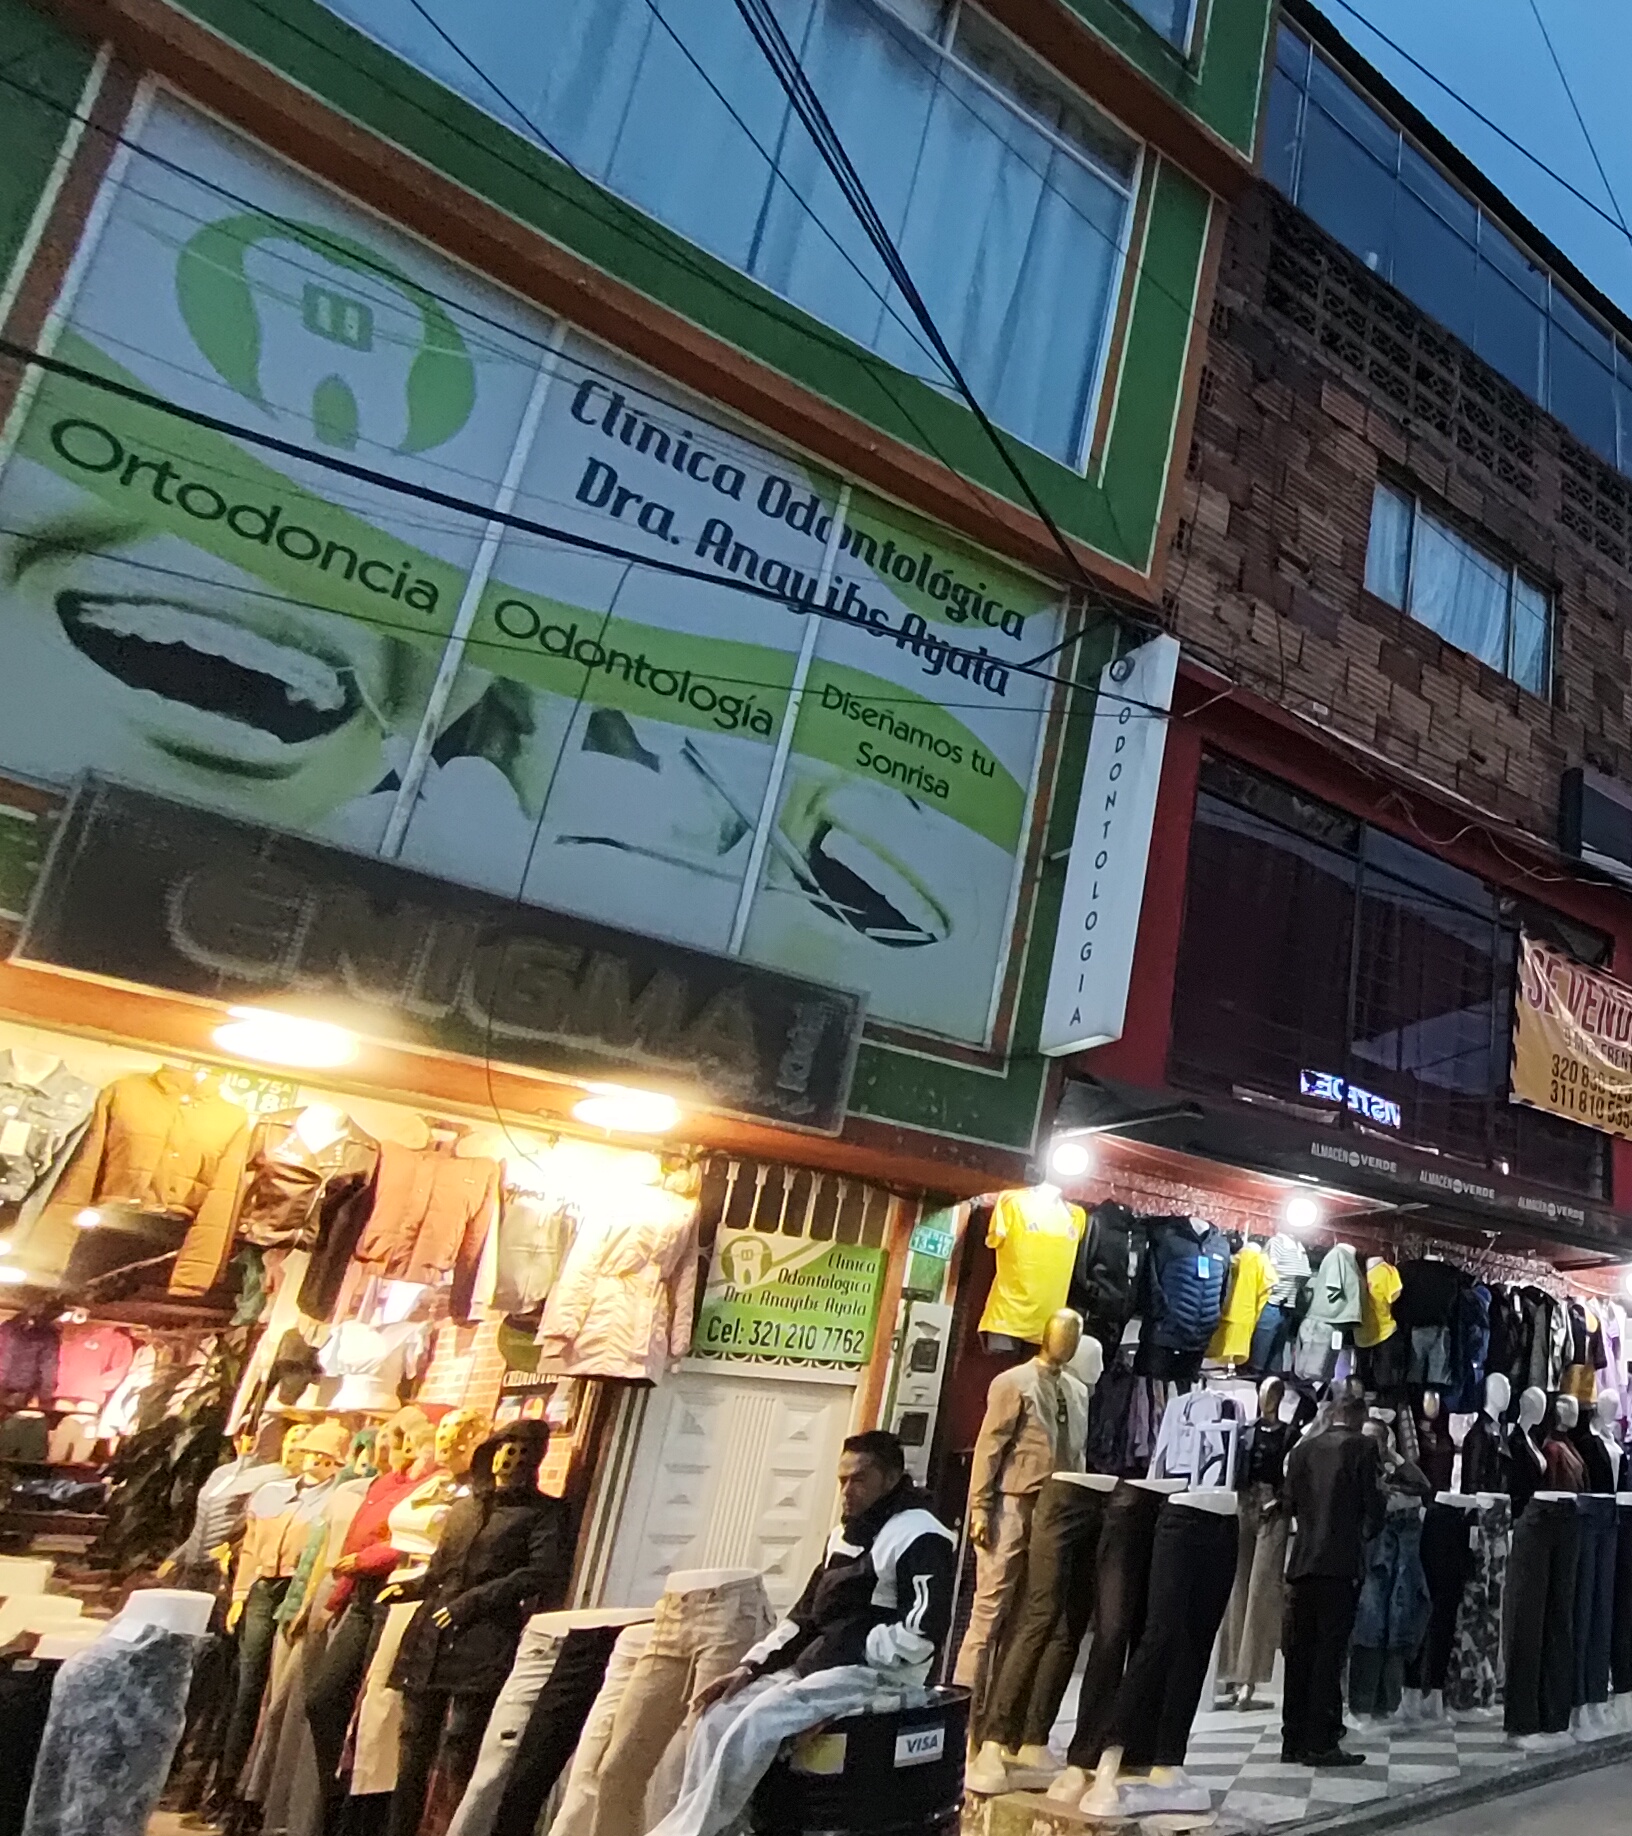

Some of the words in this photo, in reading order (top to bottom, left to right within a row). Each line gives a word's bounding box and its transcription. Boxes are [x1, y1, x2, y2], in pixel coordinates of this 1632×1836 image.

[50, 418, 440, 614] Ortodoncia
[575, 456, 680, 546] Dra.
[896, 612, 1010, 697] Ayala
[757, 475, 1026, 641] Odontológica
[494, 598, 773, 737] Odontología
[821, 683, 963, 765] Diseñamos
[970, 749, 996, 778] tu
[856, 740, 950, 800] Sonrisa
[1069, 707, 1131, 1027] ODONTOLOGIA
[1527, 948, 1562, 1020] SE
[1550, 1079, 1574, 1109] 311
[1551, 1054, 1579, 1084] 320
[1360, 1154, 1397, 1173] VERDE
[1461, 1182, 1495, 1200] VERDE
[706, 1315, 745, 1345] Cel:
[748, 1319, 781, 1348] 321
[784, 1322, 817, 1351] 210
[821, 1325, 865, 1355] 7762
[823, 1297, 867, 1318] Ayala
[906, 1733, 938, 1754] VISA
